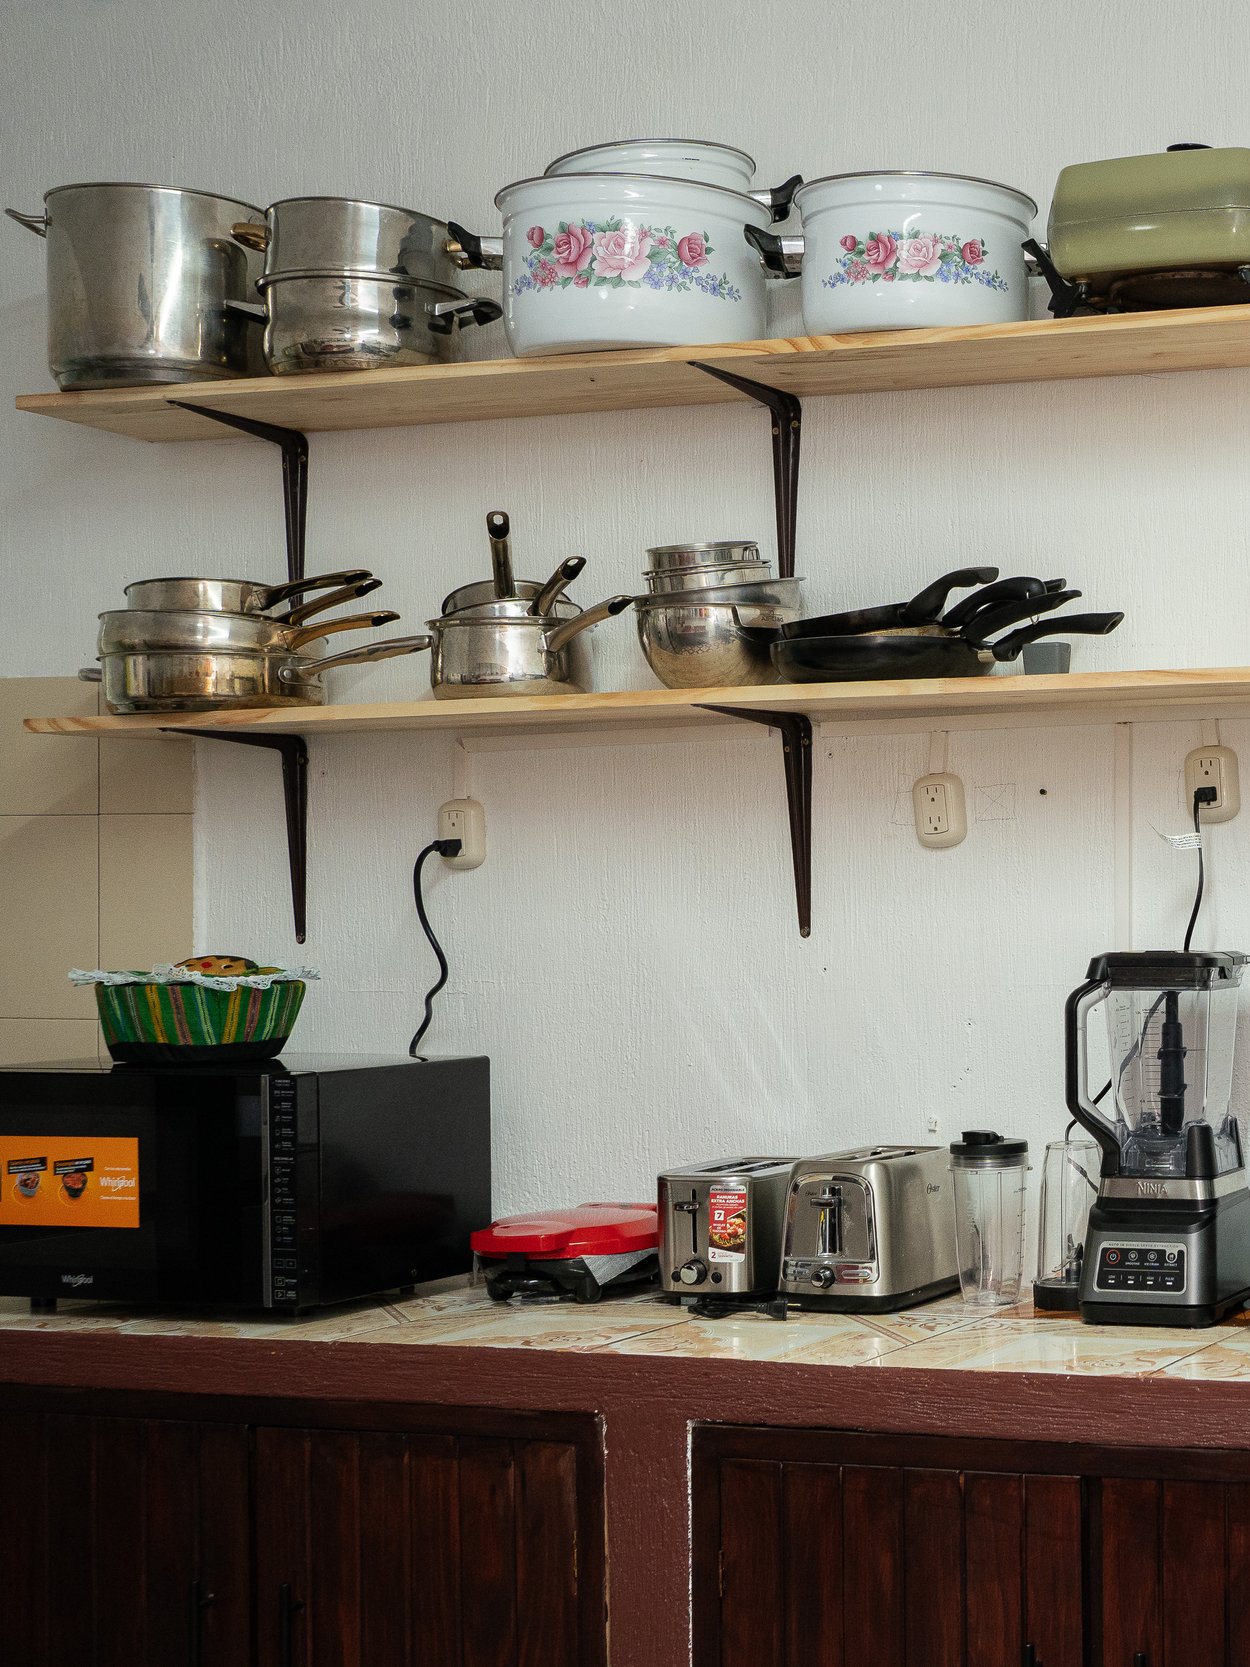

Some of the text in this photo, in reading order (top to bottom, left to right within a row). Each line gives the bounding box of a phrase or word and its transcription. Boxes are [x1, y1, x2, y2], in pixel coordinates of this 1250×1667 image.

[99, 1176, 136, 1191] Whirlpool
[926, 1183, 940, 1195] Oster
[1137, 1181, 1168, 1197] NINJA
[711, 1251, 716, 1259] 2
[61, 1274, 93, 1287] Whirlpool
